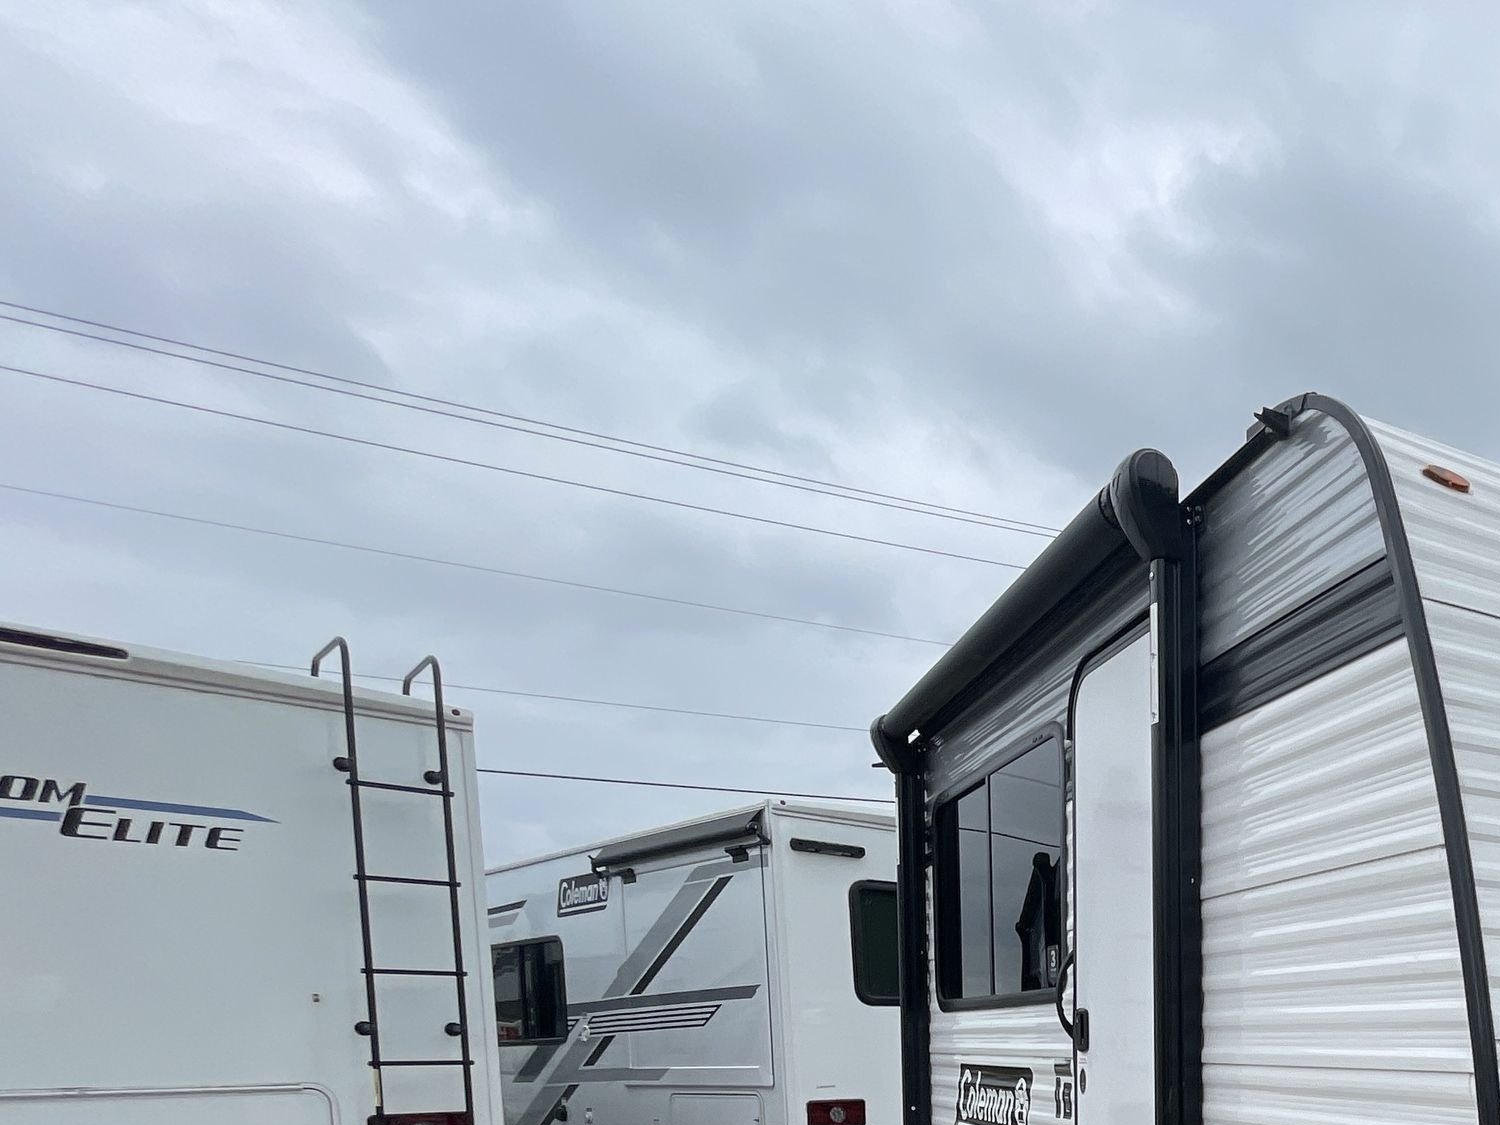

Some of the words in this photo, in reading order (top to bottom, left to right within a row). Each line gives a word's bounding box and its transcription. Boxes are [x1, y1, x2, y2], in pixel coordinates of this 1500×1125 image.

[60, 807, 245, 851] ELITE
[560, 880, 599, 908] Coleman
[960, 1068, 1015, 1125] Coleman
